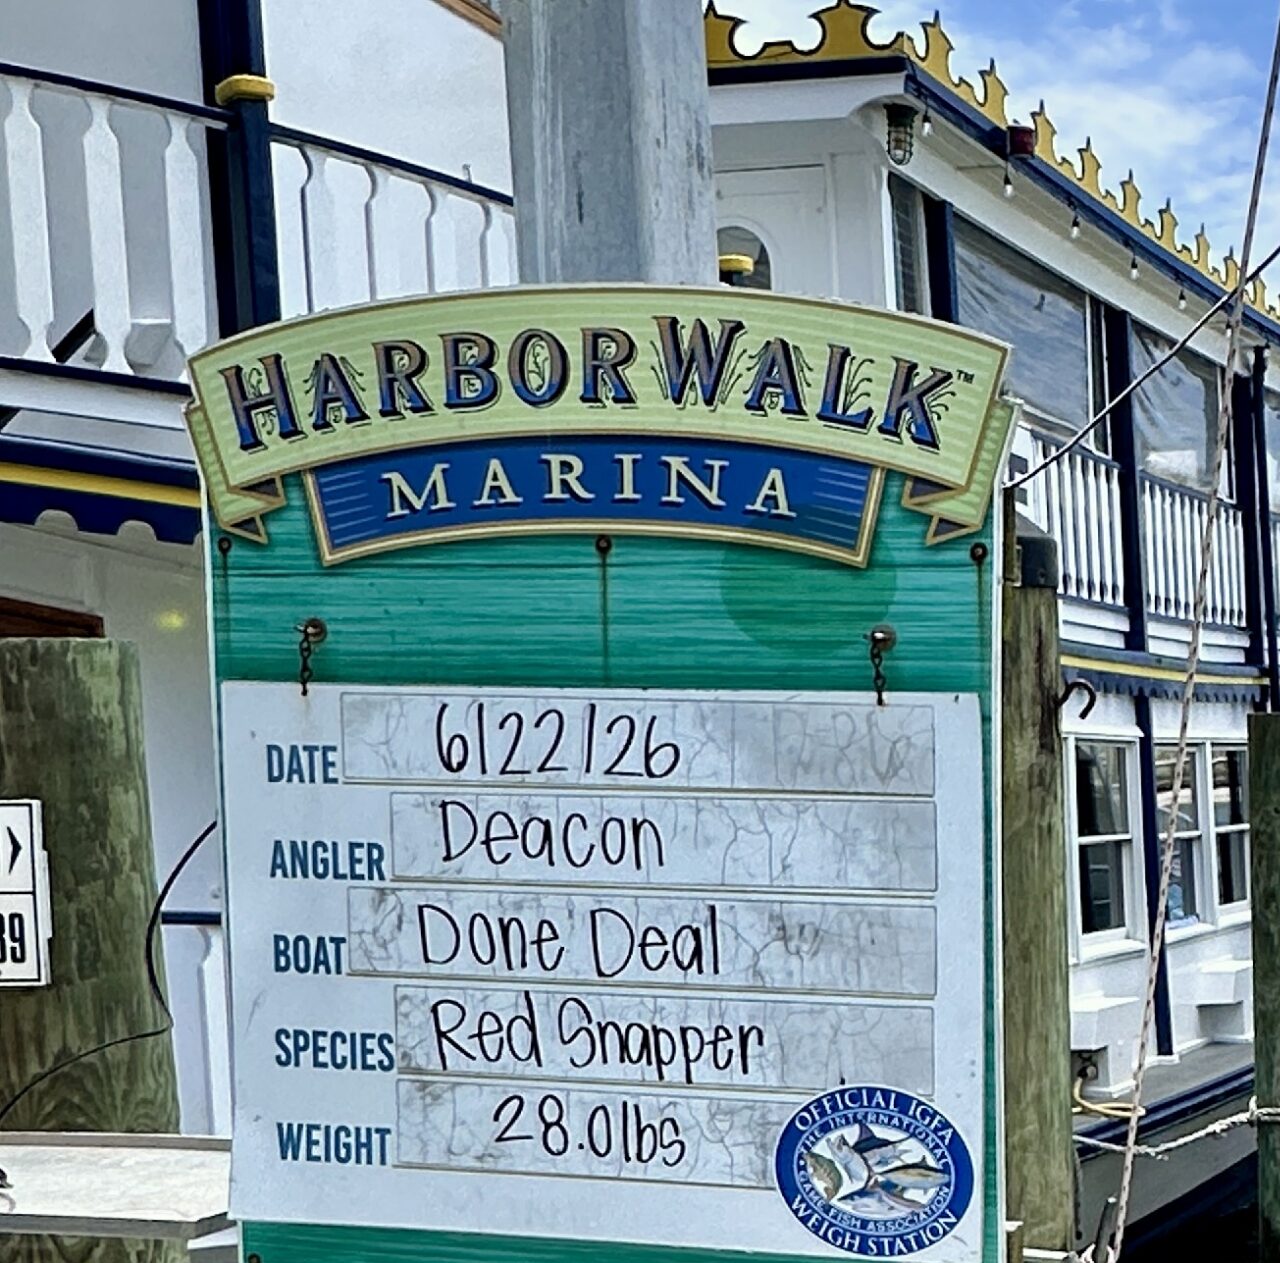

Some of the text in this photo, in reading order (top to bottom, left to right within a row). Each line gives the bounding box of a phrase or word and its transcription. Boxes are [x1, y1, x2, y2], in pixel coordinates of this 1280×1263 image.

[217, 315, 955, 453] HARBORWALK
[382, 454, 796, 519] MARINA
[266, 743, 339, 785] DATE
[270, 839, 386, 882] ANGLER
[440, 799, 664, 870] Deacon
[273, 934, 347, 976] BOAT
[418, 903, 721, 978] Done Deal
[274, 1028, 396, 1073] SPECIES
[431, 990, 765, 1084] Red Snapper
[277, 1121, 393, 1167] WEIGHT
[795, 1088, 956, 1146] OFFICIAL IGFA
[801, 1112, 951, 1170] THE INTERNATIONAL
[790, 1195, 959, 1256] WEIGH STATION
[799, 1173, 951, 1232] GAME FISH ASSOCIATION
